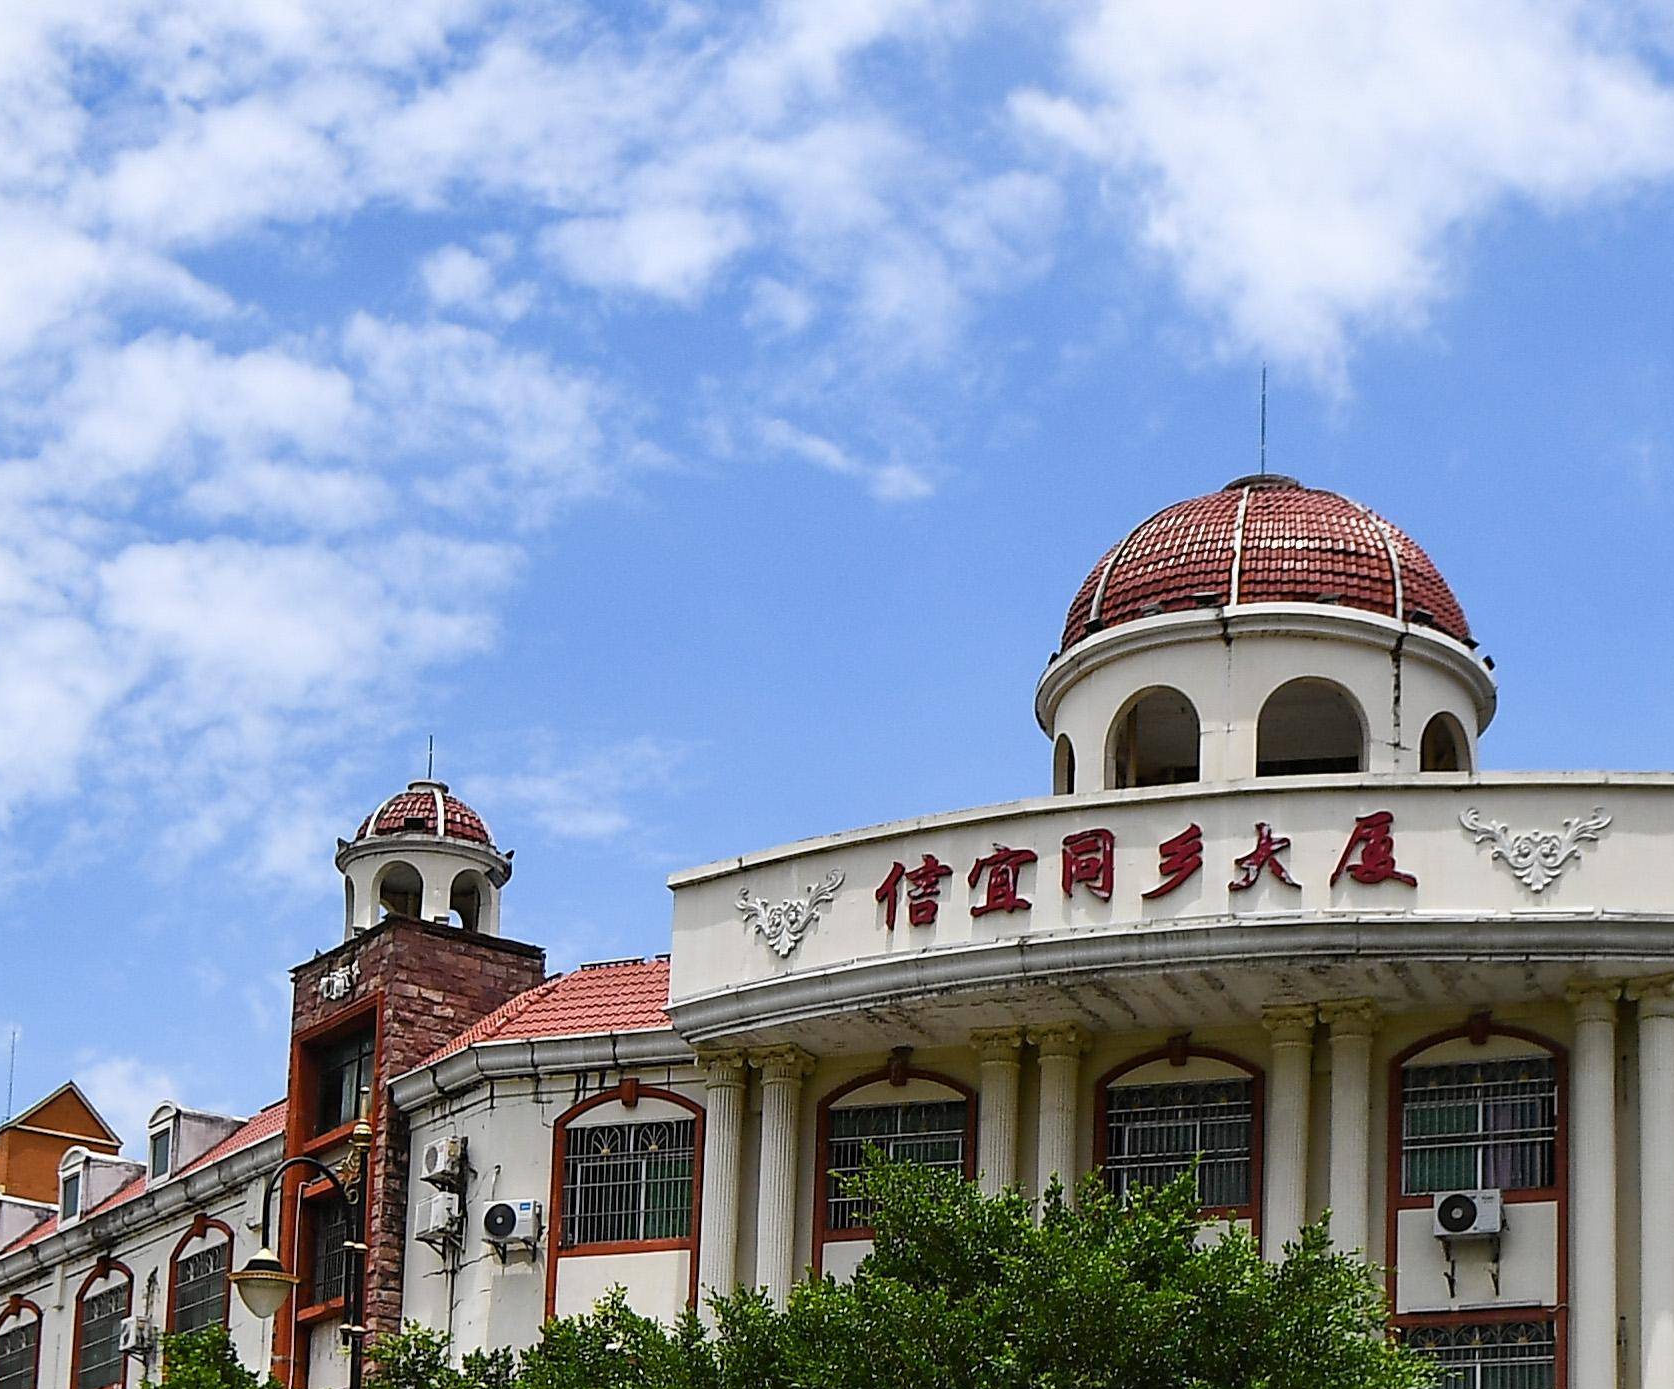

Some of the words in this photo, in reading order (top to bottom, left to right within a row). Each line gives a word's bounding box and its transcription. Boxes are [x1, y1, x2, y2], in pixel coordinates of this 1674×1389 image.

[875, 810, 1417, 930] 信宜同乡大厦
